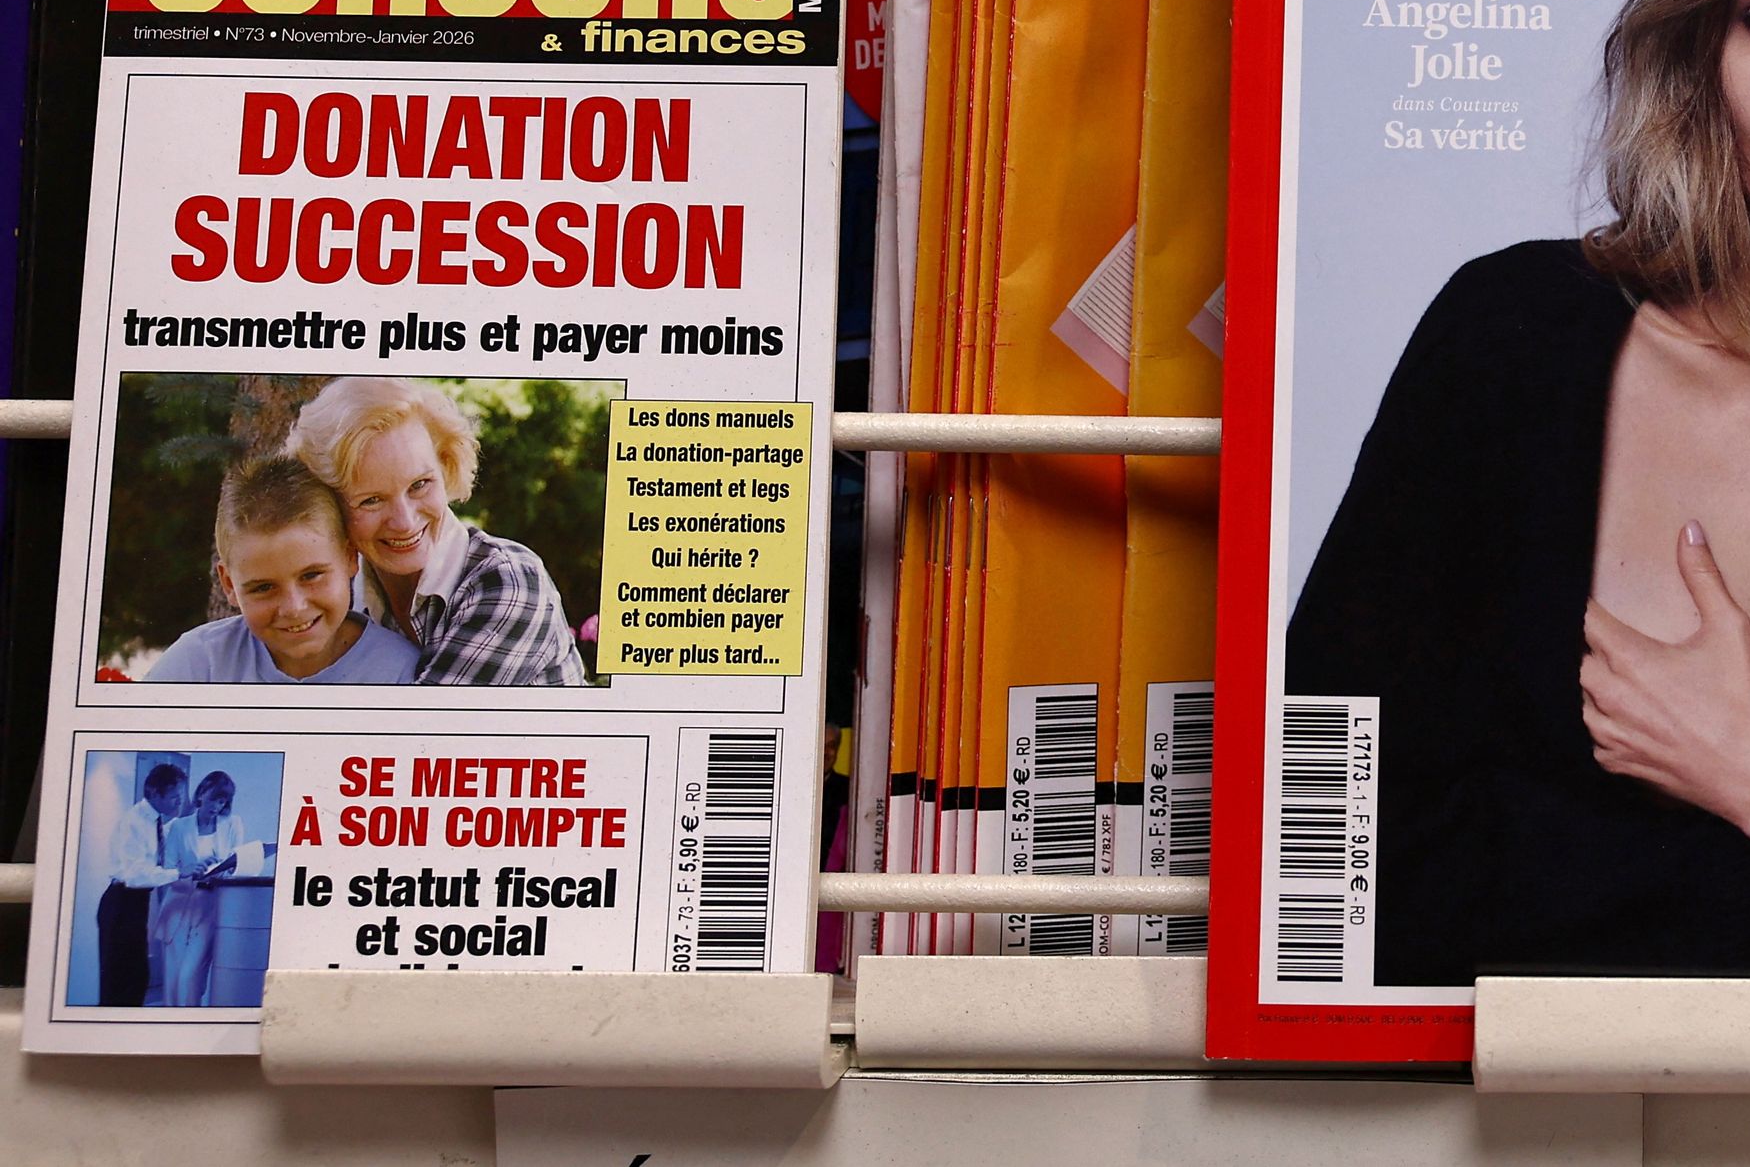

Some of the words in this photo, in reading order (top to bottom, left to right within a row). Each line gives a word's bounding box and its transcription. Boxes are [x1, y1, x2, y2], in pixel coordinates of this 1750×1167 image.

[133, 24, 210, 42] trimestriel
[281, 27, 429, 46] Novembre-Janvier
[432, 30, 475, 47] 2026
[582, 21, 806, 55] finances
[1407, 41, 1504, 89] Jolie
[1392, 95, 1437, 113] dans
[1440, 95, 1521, 114] Coutures
[239, 91, 692, 183] DONATION
[1382, 121, 1423, 152] Sa
[1430, 117, 1527, 153] vérité
[171, 194, 745, 290] SUCCESSION
[124, 308, 367, 351] transmettre
[378, 311, 467, 360] plus
[479, 316, 521, 353] et
[533, 320, 649, 364] payer
[659, 313, 785, 358] moins
[628, 407, 660, 428] Les
[665, 408, 710, 428] dons
[716, 410, 795, 429] manuels
[616, 442, 637, 462] La
[643, 443, 804, 468] donation-partage
[627, 476, 723, 498] Testament
[728, 479, 746, 498] et
[751, 479, 790, 503] legs
[628, 512, 660, 532] Les
[665, 512, 786, 534] exonérations
[651, 547, 682, 570] Qui
[687, 547, 743, 568] hérite
[618, 581, 708, 603] Comment
[712, 583, 790, 604] déclarer
[621, 609, 640, 628] et
[645, 608, 725, 629] combien
[731, 612, 784, 633] payer
[621, 643, 681, 667] Payer
[679, 644, 719, 668] plus
[724, 644, 781, 665] tard...
[1353, 732, 1372, 782] 17173
[338, 755, 395, 797] SE
[410, 757, 587, 798] METTRE
[1012, 789, 1033, 823] 5,20
[1149, 784, 1171, 818] 5,20
[291, 795, 323, 847] À
[338, 805, 432, 848] SON
[444, 805, 626, 850] COMPTE
[678, 837, 701, 874] 5,90
[292, 866, 334, 909] le
[347, 866, 481, 910] statut
[495, 867, 618, 910] fiscal
[355, 916, 402, 956] et
[413, 914, 548, 958] social
